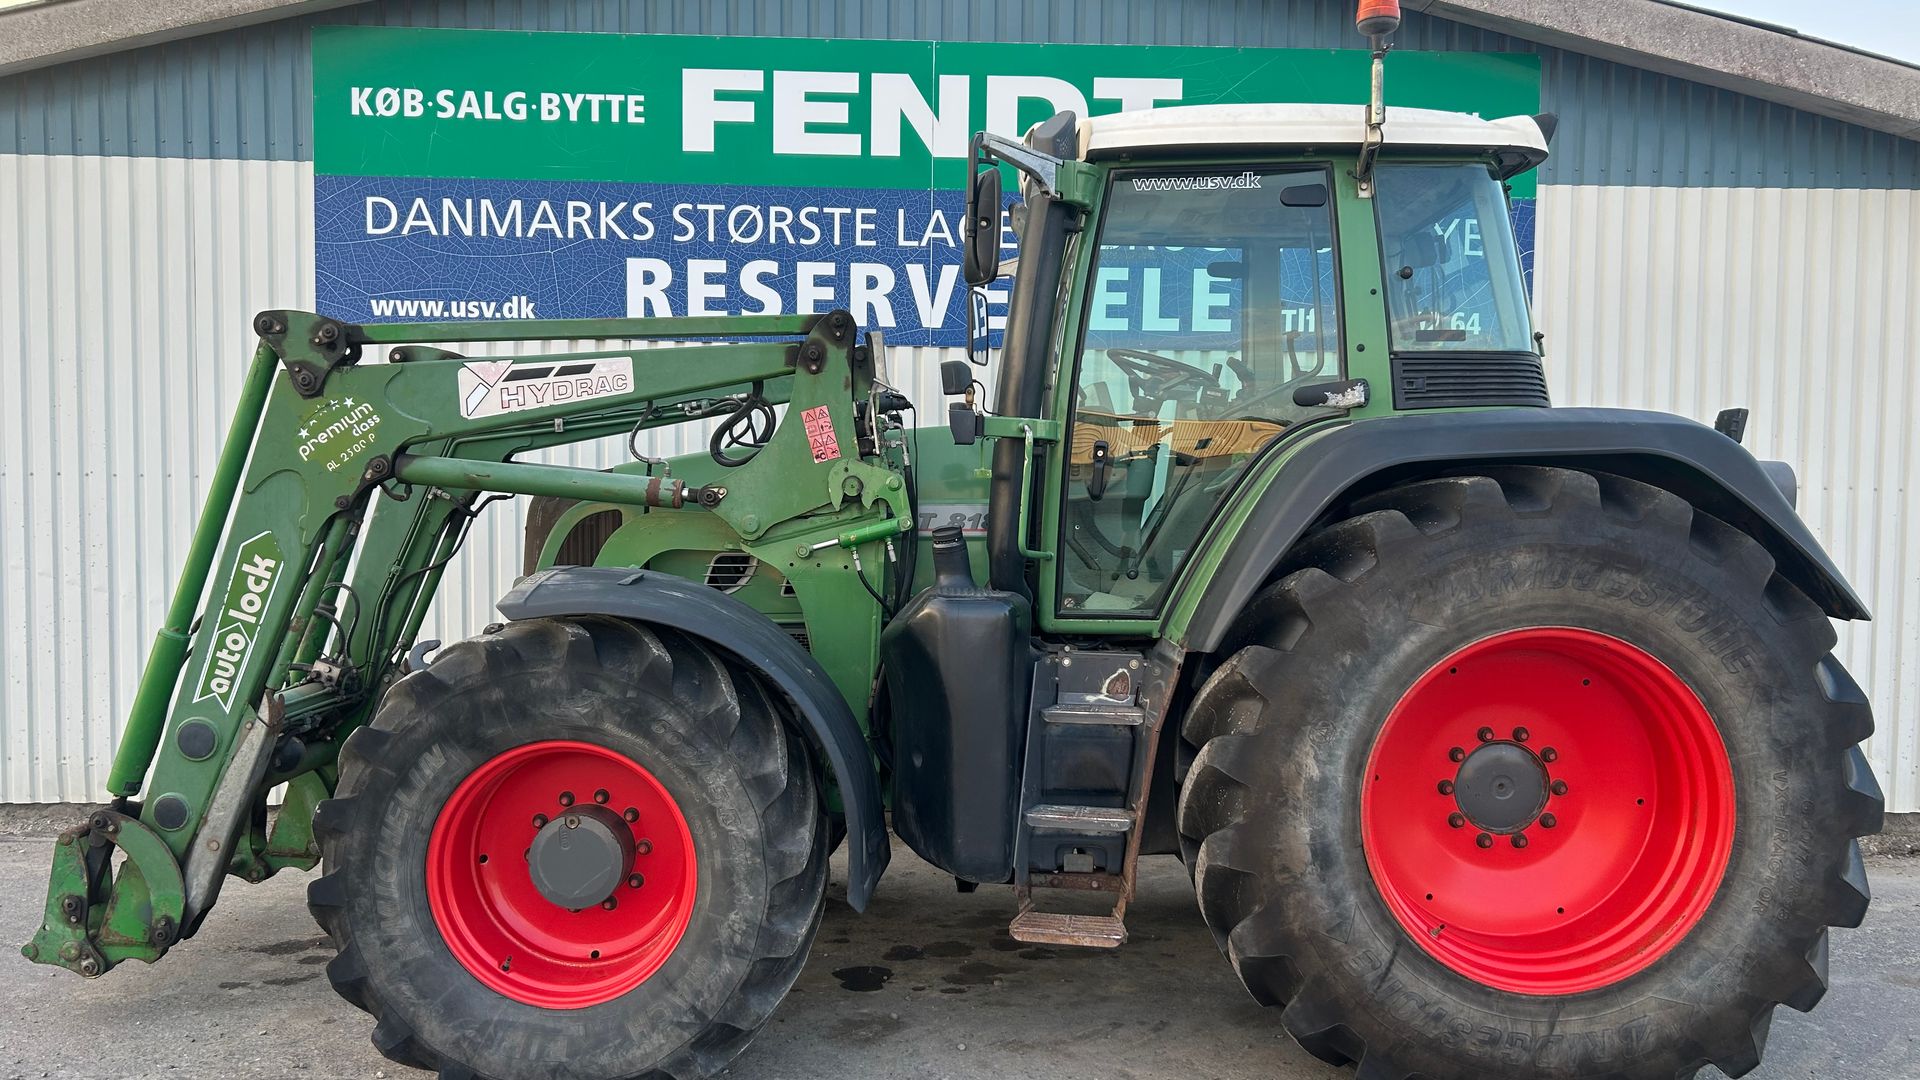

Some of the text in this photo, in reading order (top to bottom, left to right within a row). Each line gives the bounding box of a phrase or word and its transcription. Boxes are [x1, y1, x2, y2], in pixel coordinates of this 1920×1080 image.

[682, 68, 1183, 158] FENDT
[1132, 172, 1261, 191] www.usv.dk
[365, 196, 655, 242] DANMARKS
[672, 202, 876, 247] STØRSTE
[370, 296, 535, 320] www.usv.dk
[500, 373, 629, 410] HYDRAC
[298, 402, 374, 462] premium
[352, 414, 381, 437] class
[209, 553, 277, 694] auto lock
